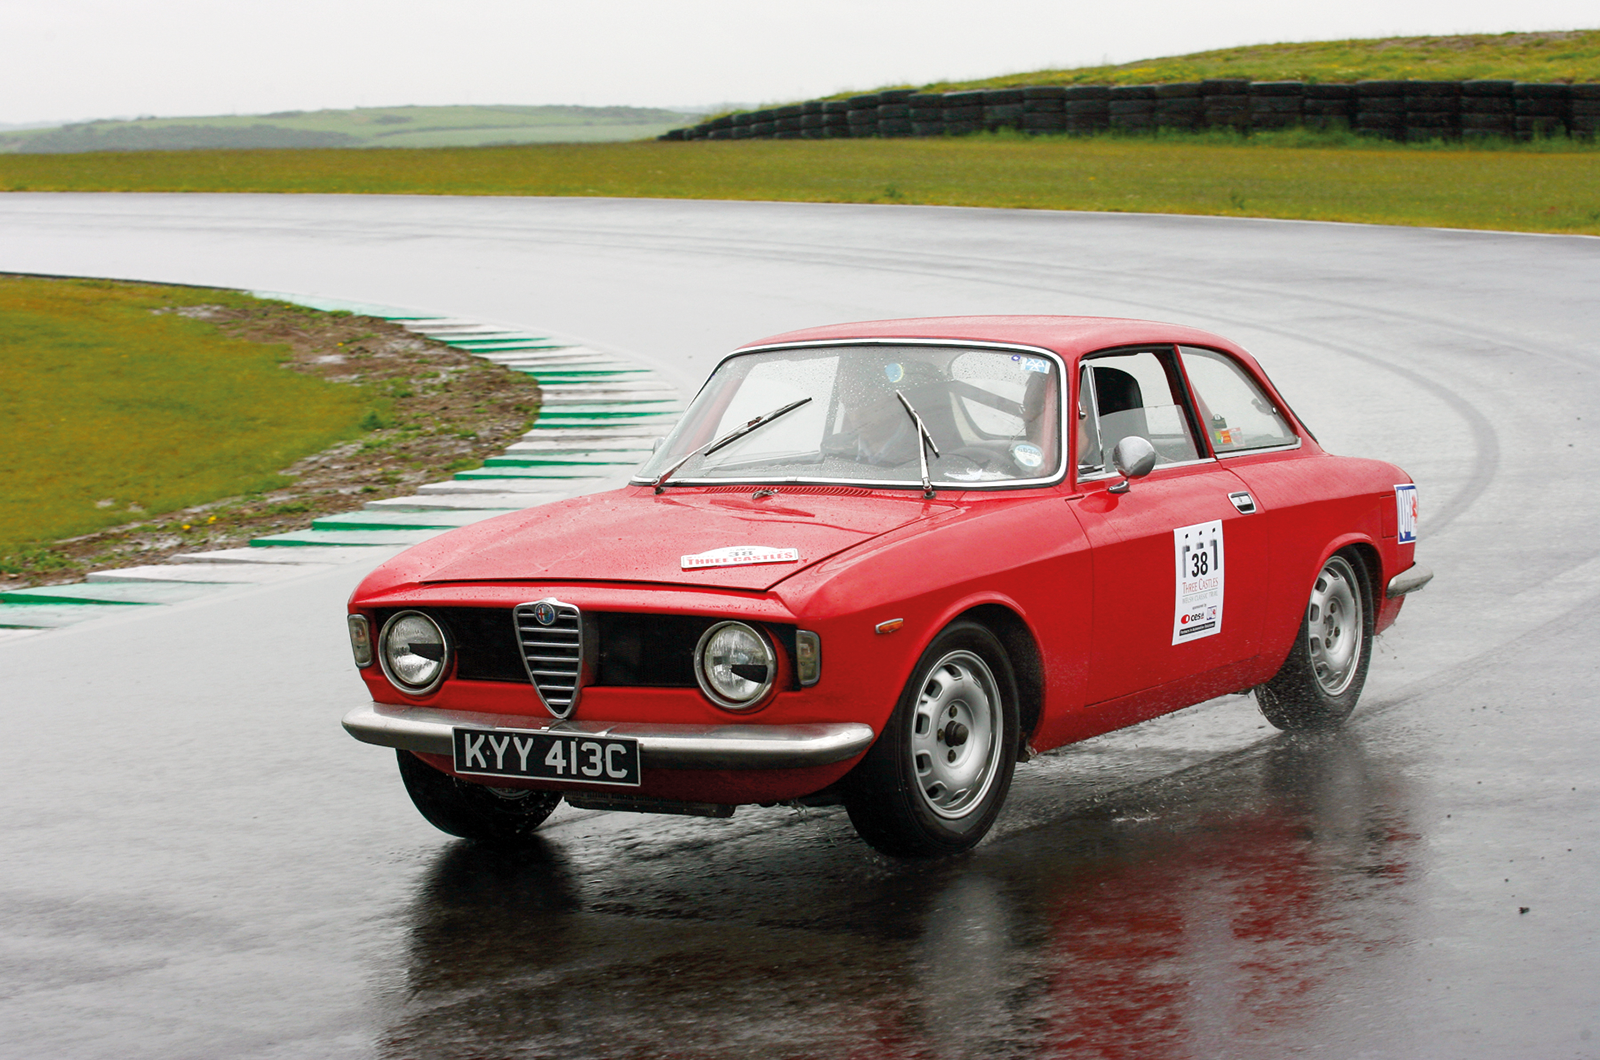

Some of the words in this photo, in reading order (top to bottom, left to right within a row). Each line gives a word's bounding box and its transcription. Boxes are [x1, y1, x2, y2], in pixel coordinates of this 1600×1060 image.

[733, 552, 793, 562] CASTLES
[1191, 551, 1208, 577] 38
[1182, 582, 1197, 594] THREE
[1198, 577, 1218, 590] CASTLES
[464, 733, 534, 772] KYY
[544, 740, 628, 779] 413C
